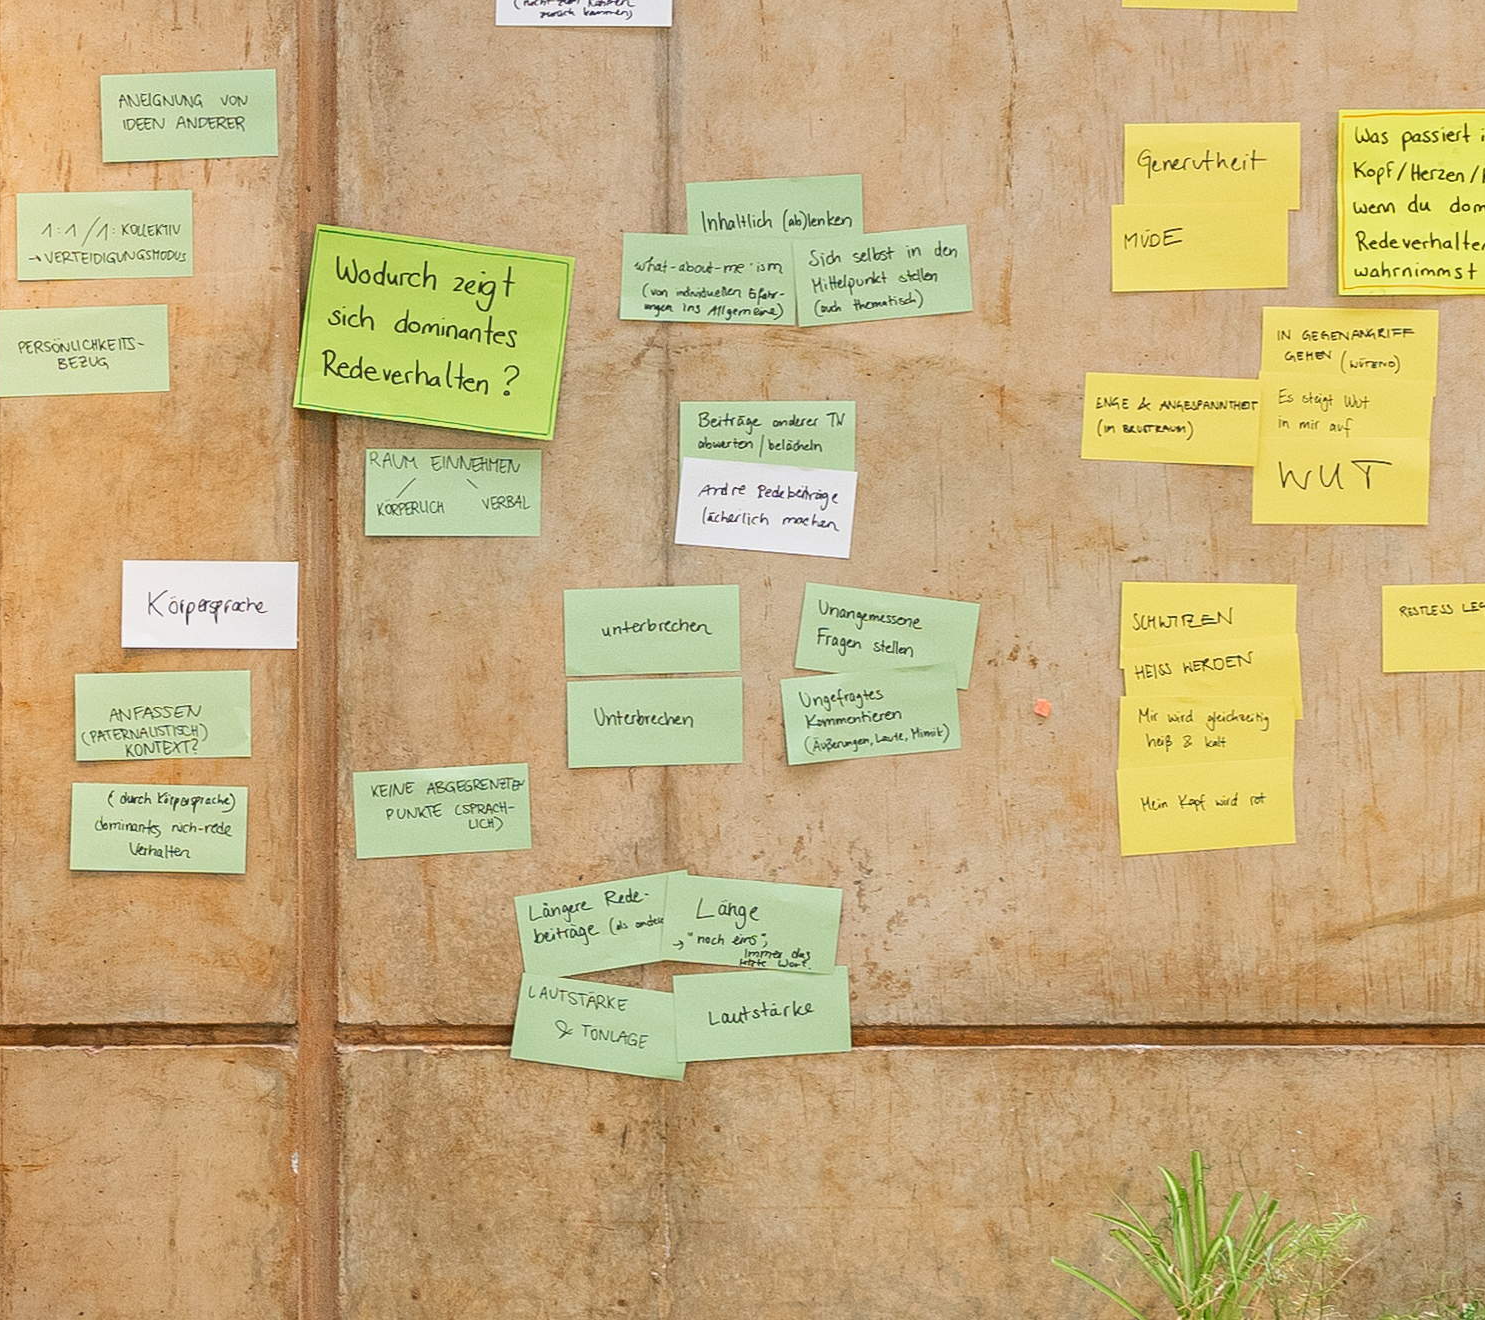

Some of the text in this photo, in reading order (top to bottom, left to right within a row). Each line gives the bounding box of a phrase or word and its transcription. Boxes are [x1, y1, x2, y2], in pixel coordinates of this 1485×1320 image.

[118, 92, 249, 109] ANEIGNUNG VON
[122, 115, 246, 132] IDEEN ANDERER
[1354, 126, 1389, 145] Was
[1401, 122, 1471, 152] passiert
[1352, 201, 1396, 215] wenn
[1407, 193, 1432, 214] du
[700, 208, 853, 234] Inhaltlich (ab)lenken
[1124, 227, 1184, 250] MÜDE
[43, 248, 187, 265] VERTEIDIGUNGSMODUS
[808, 240, 958, 267] Sich selbst in den
[811, 267, 938, 296] Mittelpunkt stellen
[1353, 261, 1478, 280] wahrnimmst
[335, 255, 516, 313] Wodurch zeigt
[327, 304, 518, 349] sich dominantes
[1277, 327, 1415, 342] IN GEGENANGRIFF
[57, 355, 110, 371] BEZUG
[321, 348, 489, 396] Redeverhalten
[1278, 388, 1370, 413] Es steigt Wut
[698, 411, 846, 436] Beiträge anderer TN
[1278, 417, 1354, 438] in mir auf
[369, 450, 521, 474] RAUM EINNEHMEN
[1278, 459, 1393, 491] WUT
[376, 494, 531, 517] KÖRPERLICH VERBAL
[702, 506, 840, 532] lächerlich machen
[147, 589, 269, 626] Körpersprache
[817, 599, 923, 635] Unangemessene
[1398, 603, 1454, 618] RESTLESS
[601, 618, 713, 638] unterbrechen
[816, 626, 914, 658] Fragen stellen
[1134, 650, 1253, 680] HEISS WERDEN
[798, 688, 885, 712] Ungefragtes
[109, 704, 202, 723] ANFASSEN
[593, 706, 694, 728] Unterbrechen
[804, 710, 902, 729] Kommentieren
[81, 722, 209, 751] (PATERNALISTISCH)
[124, 737, 201, 760] KONTEXT?
[1140, 792, 1267, 812] Mein Kopf wird rot
[528, 900, 593, 923] Längere
[695, 897, 760, 930] Länge
[528, 984, 631, 1012] LAUTSTÄRKE
[708, 1000, 815, 1026] Lautstärke
[581, 1023, 649, 1050] TONLAGE
